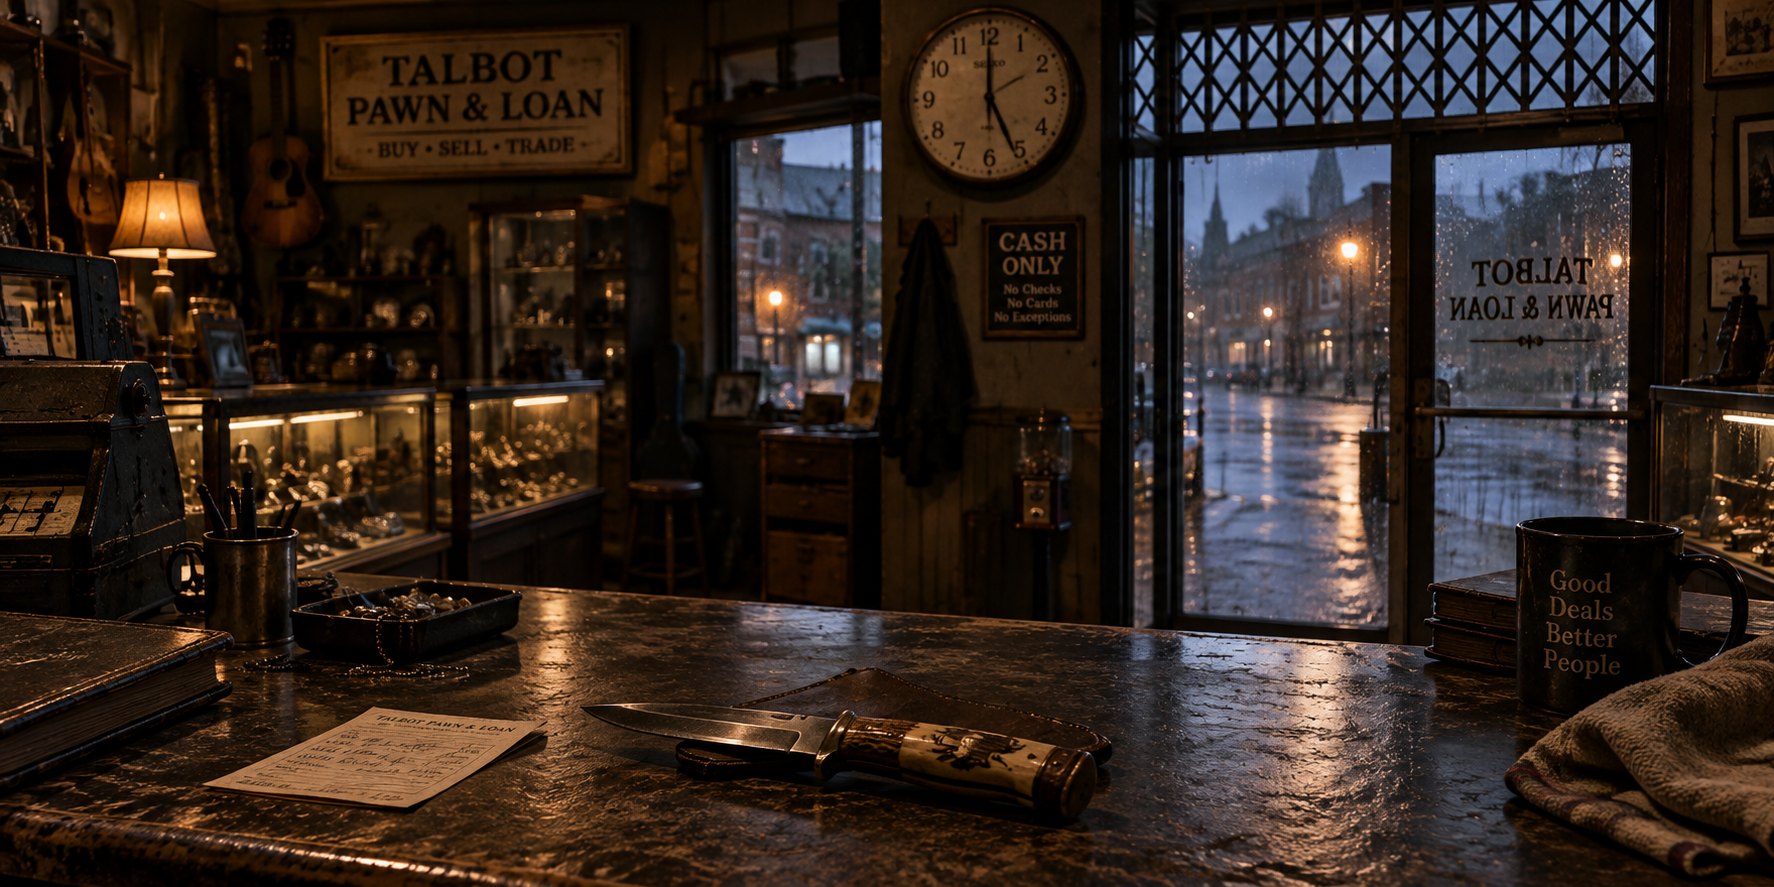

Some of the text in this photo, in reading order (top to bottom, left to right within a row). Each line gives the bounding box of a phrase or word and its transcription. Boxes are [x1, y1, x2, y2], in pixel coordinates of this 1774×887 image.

[952, 36, 966, 55] 11
[980, 27, 999, 46] 12
[1017, 33, 1024, 52] 1
[382, 50, 562, 86] TALBOT
[931, 60, 949, 78] 10
[973, 59, 1006, 69] SEKO
[1036, 54, 1049, 73] 2
[922, 90, 935, 109] 9
[1044, 86, 1057, 105] 3
[346, 88, 604, 126] PAWN & LOAN
[931, 121, 944, 139] 8
[1035, 117, 1048, 136] 4
[378, 136, 575, 158] BUY SELL TRADE
[953, 141, 966, 160] 7
[1014, 140, 1026, 159] 5
[983, 148, 996, 167] 6
[998, 231, 1067, 252] CASH
[1002, 255, 1064, 276] ONLY
[1003, 283, 1062, 295] No Checks
[1007, 297, 1059, 309] No Cards
[994, 311, 1072, 325] No Exceptions
[1550, 568, 1613, 594] Good
[1549, 595, 1614, 621] Deals
[1545, 621, 1618, 648] Better
[1543, 648, 1621, 680] People
[376, 715, 425, 725] TALBOT
